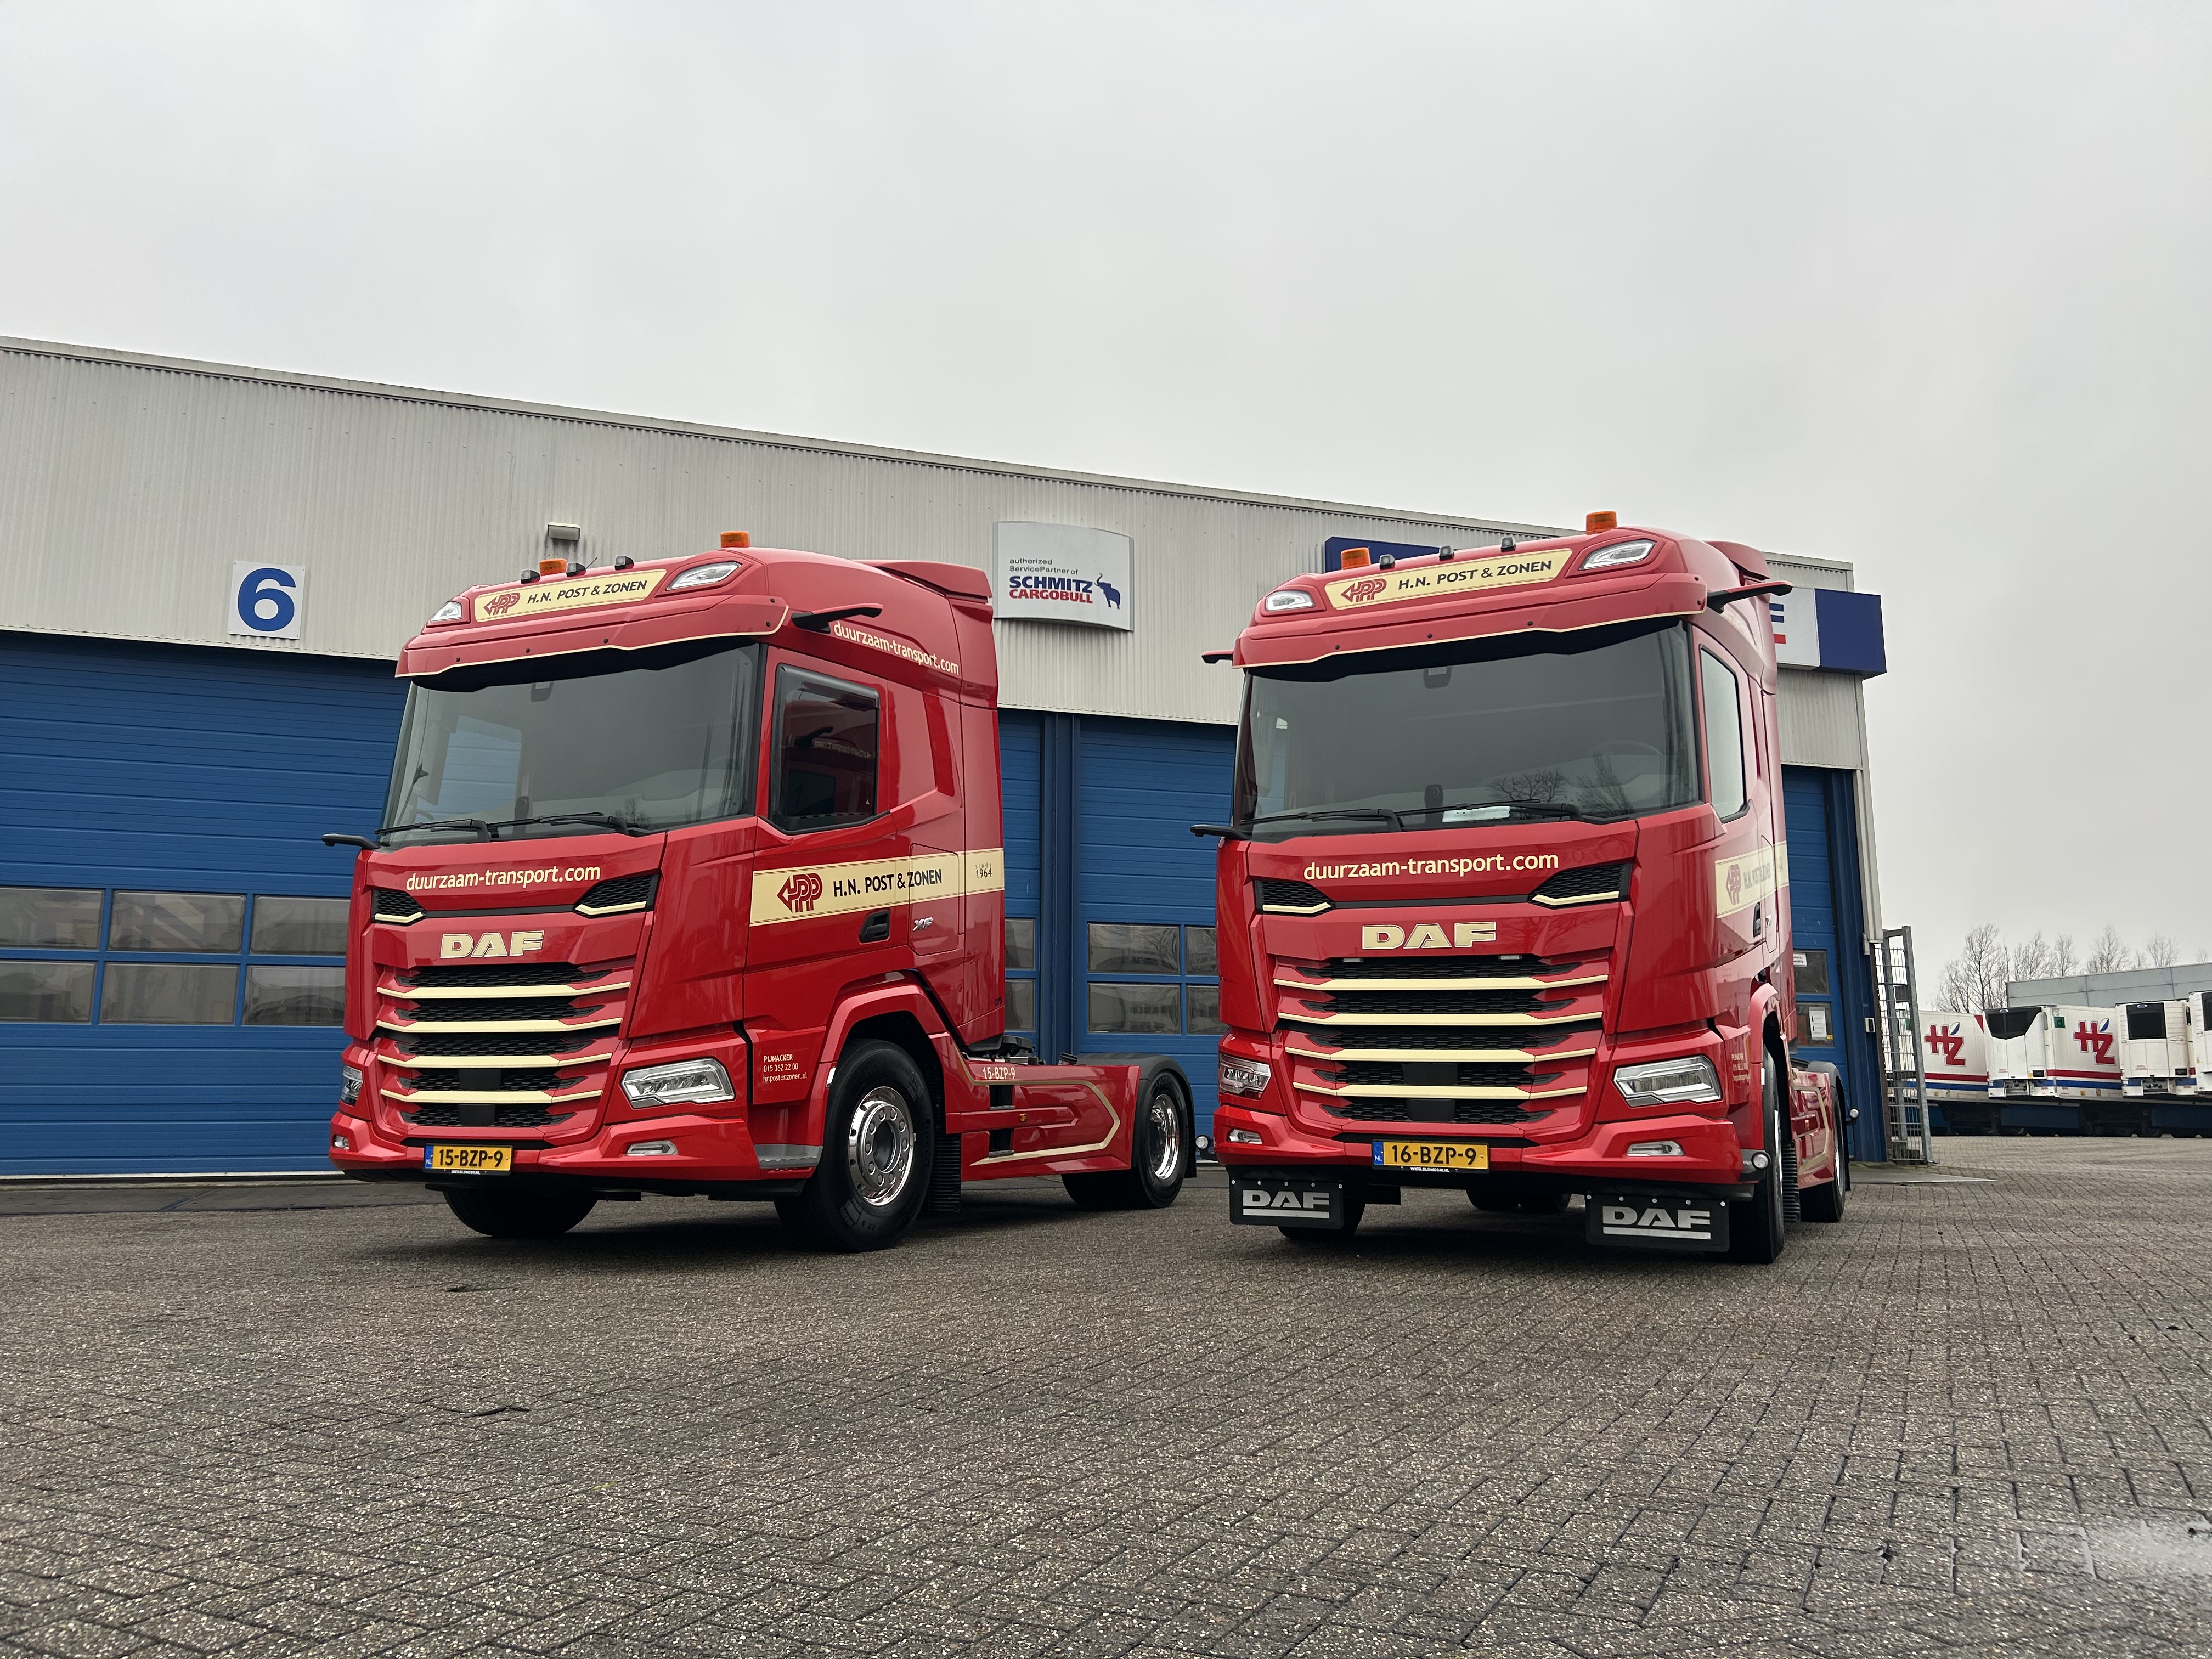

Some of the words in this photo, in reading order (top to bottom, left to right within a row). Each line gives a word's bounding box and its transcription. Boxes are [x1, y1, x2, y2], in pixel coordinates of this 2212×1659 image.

[1009, 566, 1070, 574] ServicePartner
[1398, 576, 1431, 590] H.N.
[1436, 569, 1479, 584] POST
[1480, 568, 1493, 578] &
[1497, 560, 1553, 577] ZONEN
[527, 591, 552, 605] H.N.
[556, 586, 590, 601] POST
[590, 585, 601, 596] &
[602, 580, 648, 595] ZONEN
[1009, 575, 1093, 594] SCHMITZ
[237, 567, 297, 632] 6
[1009, 589, 1093, 604] CARGOBULL
[833, 620, 960, 675] duurzaam-transport.com
[975, 868, 992, 879] 1964
[1304, 853, 1559, 880] duurzaam-transport.com
[406, 866, 601, 891] duurzaam-transport.com
[833, 878, 861, 897] H.N.
[865, 874, 894, 893] POST
[896, 873, 906, 889] &
[907, 868, 943, 887] ZONEN
[912, 917, 933, 932] XF
[440, 930, 544, 958] DAF
[1362, 922, 1497, 950] DAF
[763, 1064, 774, 1073] 015
[774, 1064, 784, 1072] 362
[764, 1054, 793, 1063] PIJNACKER
[763, 1071, 808, 1084] hnpostenzonen.nl
[983, 1066, 1015, 1080] 15-BZP-9
[439, 1149, 503, 1167] 15-BZP-9
[1392, 1145, 1476, 1165] 16-BZP-9
[1243, 1189, 1330, 1209] DAF
[1602, 1206, 1711, 1229] DAF
